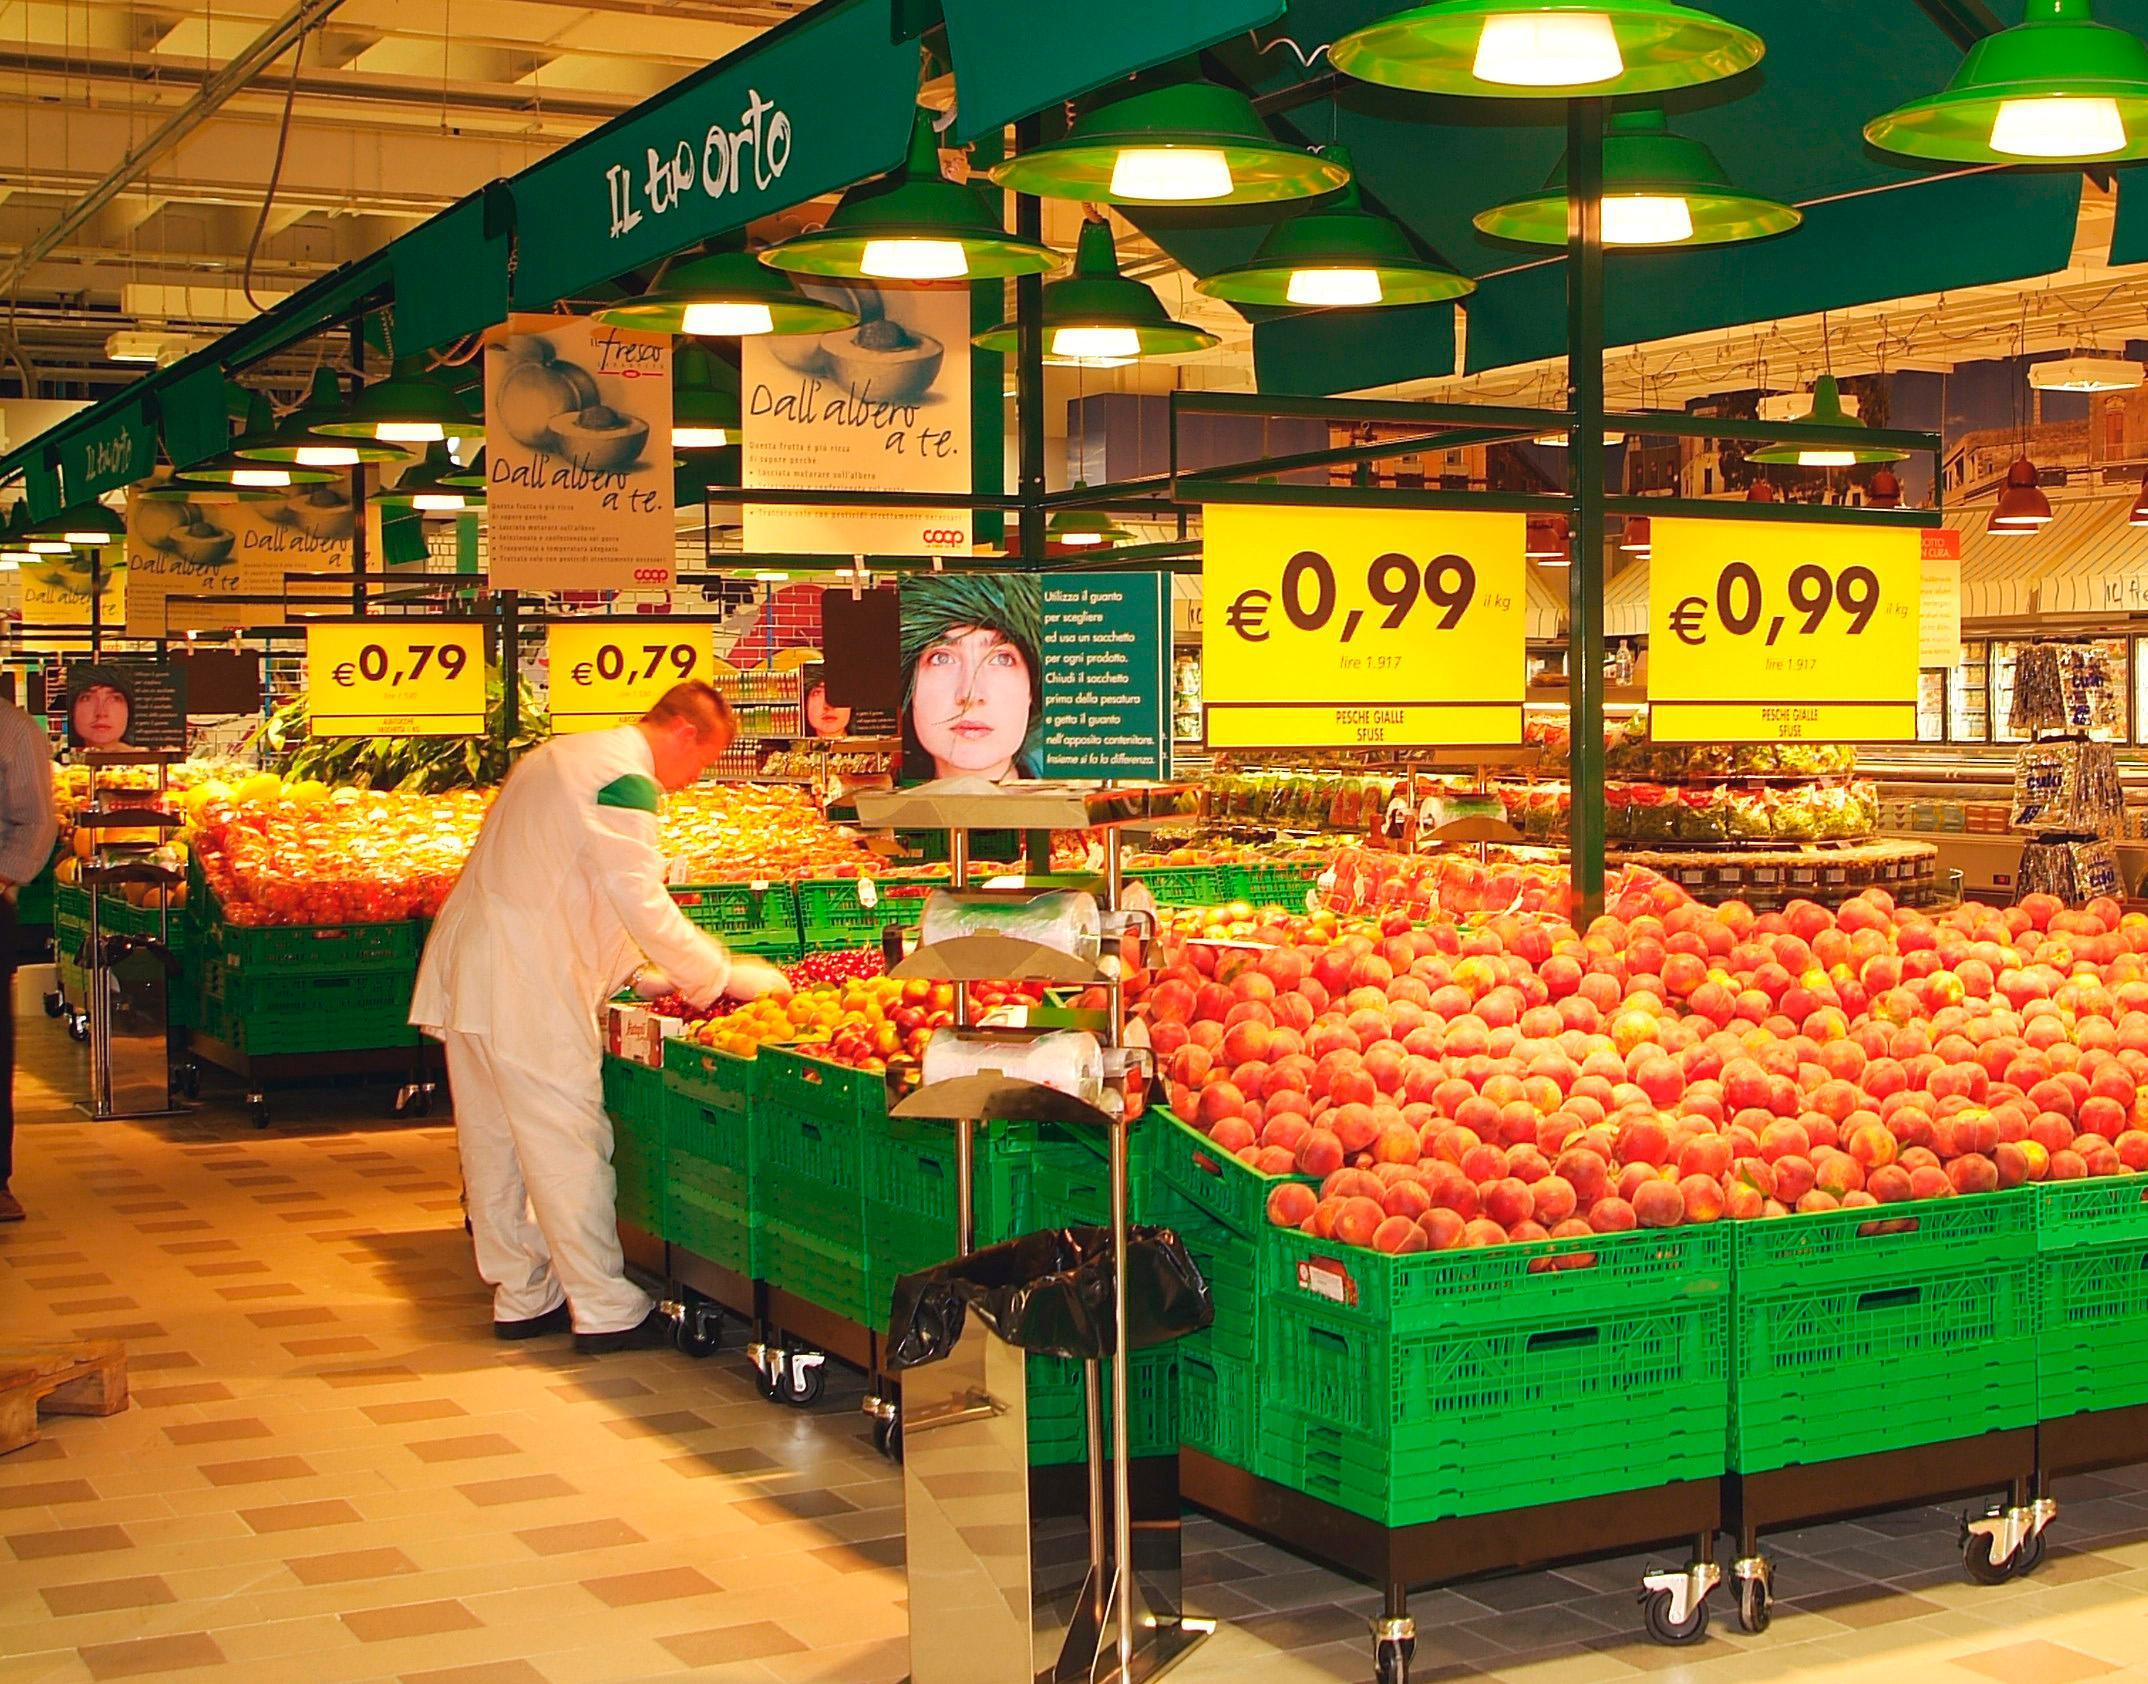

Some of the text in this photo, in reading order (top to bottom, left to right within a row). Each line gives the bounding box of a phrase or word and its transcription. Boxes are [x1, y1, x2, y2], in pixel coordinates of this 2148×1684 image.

[702, 89, 791, 198] orto
[885, 427, 958, 458] a te.
[602, 489, 662, 513] a te.
[923, 529, 965, 548] coop
[634, 569, 668, 583] coop
[1044, 589, 1123, 605] Utilizza il guanto
[1494, 594, 1511, 611] kg
[1896, 602, 1909, 618] kg
[1044, 610, 1104, 625] per scegliere
[1045, 630, 1136, 643] ed usa un sacchetto
[1045, 655, 1061, 666] per
[1063, 652, 1084, 666] ogni
[1340, 655, 1402, 670] lire 1.917
[1765, 658, 1784, 670] lire
[1045, 671, 1129, 683] Chiudi il sacchetto
[1045, 692, 1141, 706] prima della pesatura
[1045, 716, 1053, 724] e
[1054, 715, 1078, 727] getta
[1088, 715, 1121, 727] guanto
[1336, 711, 1404, 724] PESCHE GIALLE
[1762, 708, 1818, 722] PESCHE GIALLE
[1357, 728, 1384, 741] SFUSE
[1779, 725, 1801, 737] SFUSE
